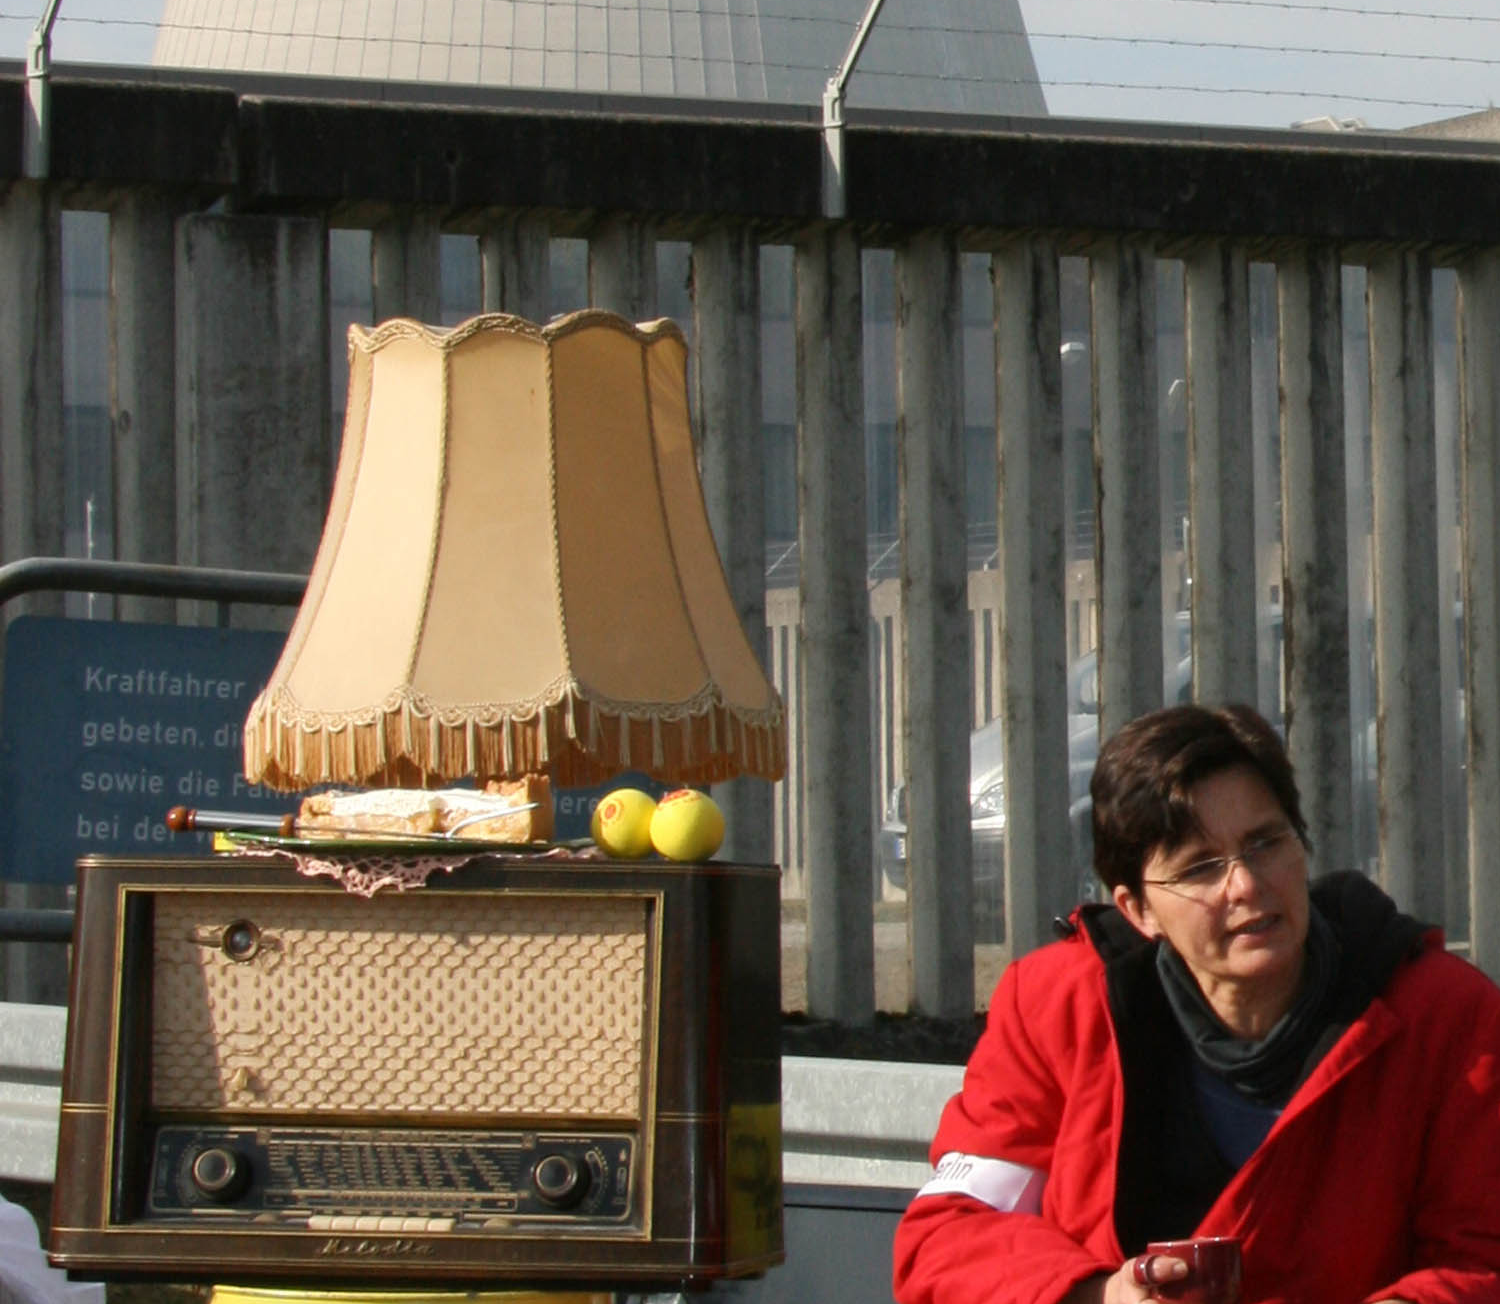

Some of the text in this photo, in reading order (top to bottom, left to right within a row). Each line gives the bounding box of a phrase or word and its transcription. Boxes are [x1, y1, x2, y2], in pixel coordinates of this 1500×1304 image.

[85, 666, 246, 699] Kraftfahrer
[214, 724, 245, 748] di
[80, 769, 164, 794] sowie
[178, 771, 220, 796] die
[77, 813, 119, 839] bei
[934, 1154, 973, 1180] erlin
